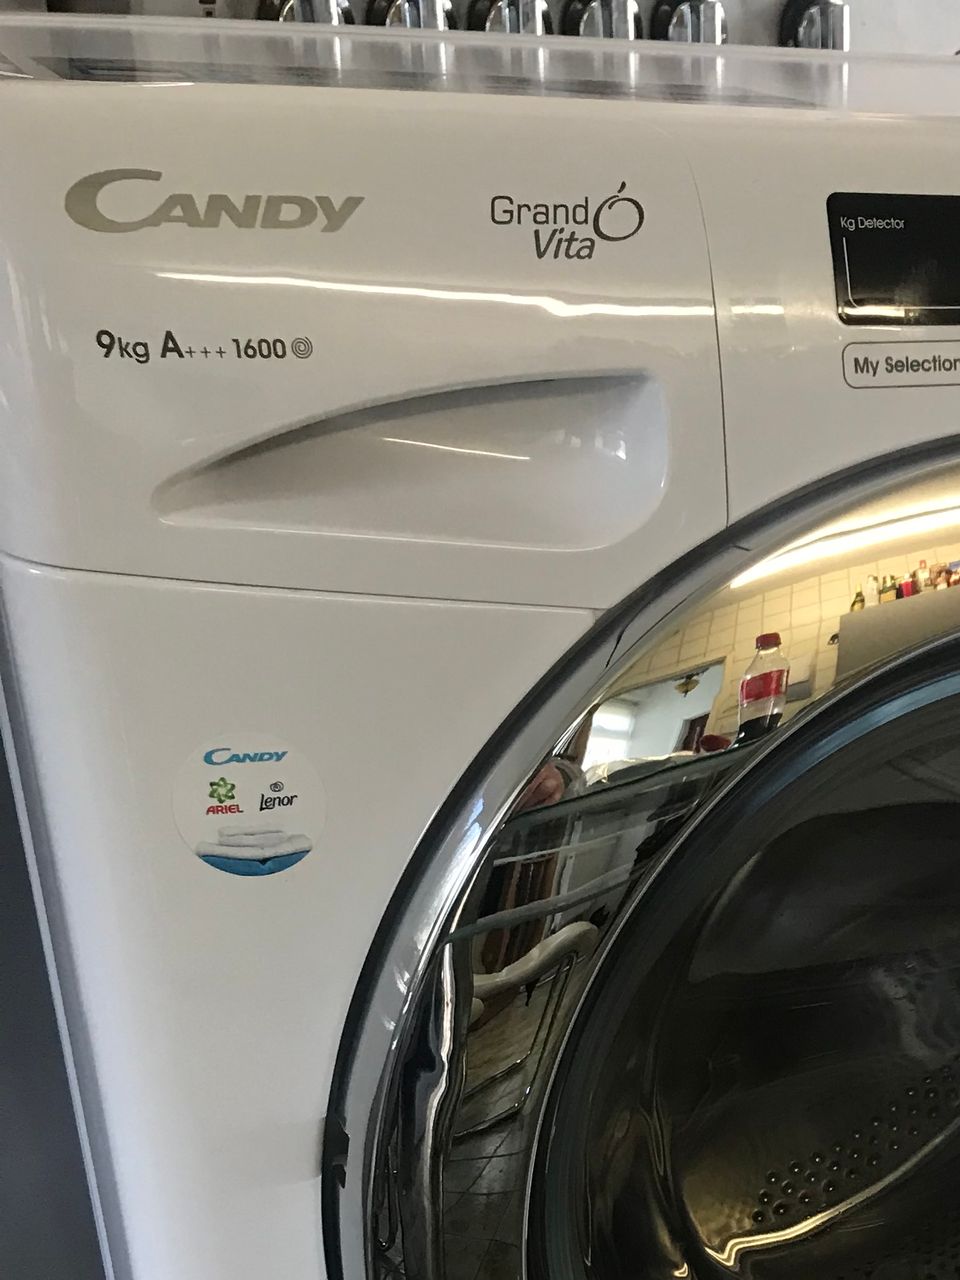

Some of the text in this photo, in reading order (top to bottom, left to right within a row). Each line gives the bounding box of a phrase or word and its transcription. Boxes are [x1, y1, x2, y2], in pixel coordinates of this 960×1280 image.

[64, 168, 366, 233] CANDY
[490, 195, 589, 225] Grand
[840, 216, 904, 231] Kg Detector
[533, 226, 596, 260] Vita
[96, 329, 150, 364] 9kg
[231, 338, 287, 359] 1600
[853, 356, 879, 377] My
[203, 748, 288, 765] CANDY
[206, 804, 244, 815] ARIEL
[259, 794, 298, 811] Lenor
